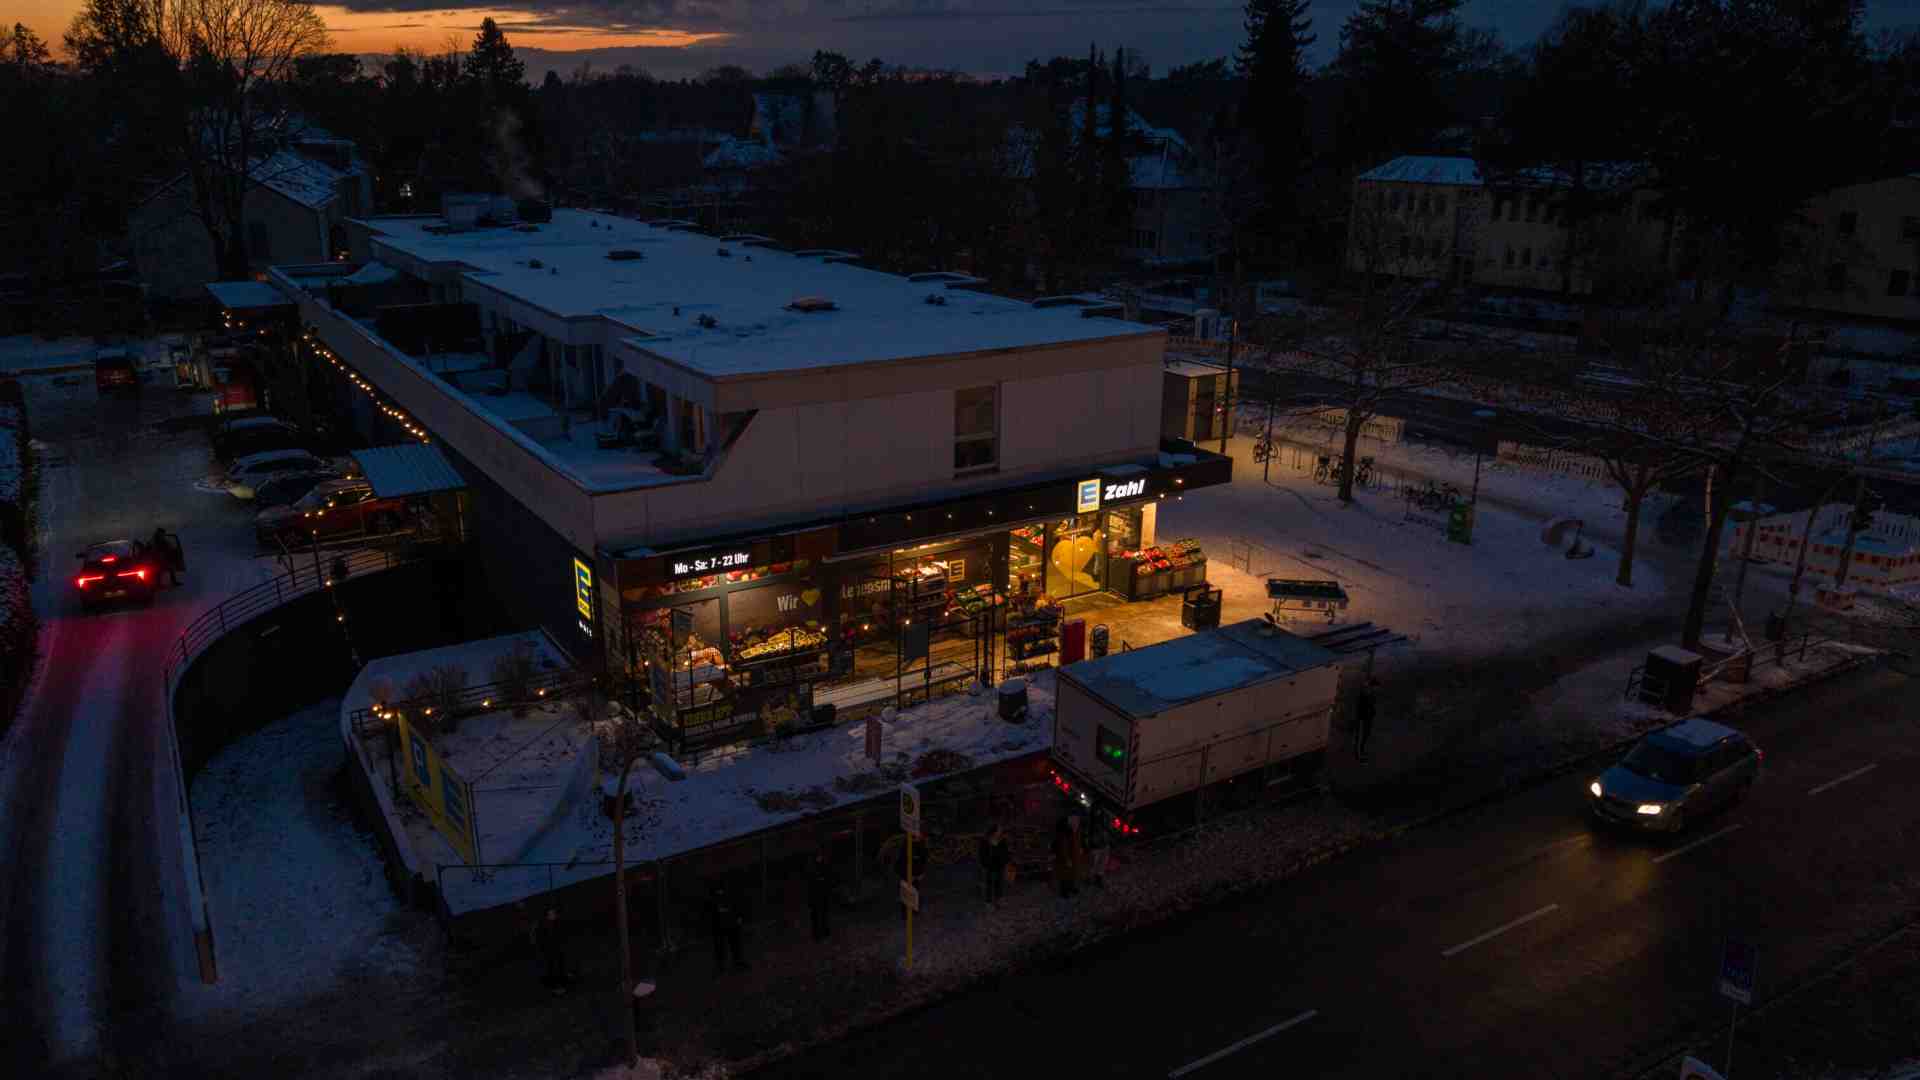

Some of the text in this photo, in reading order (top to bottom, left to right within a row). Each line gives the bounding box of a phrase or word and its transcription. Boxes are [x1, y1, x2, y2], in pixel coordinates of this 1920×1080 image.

[1104, 479, 1145, 500] Zahl
[675, 562, 688, 575] Mo
[711, 558, 716, 568] 7
[722, 556, 733, 567] 22
[734, 552, 749, 564] Uhr
[776, 593, 799, 612] Wir
